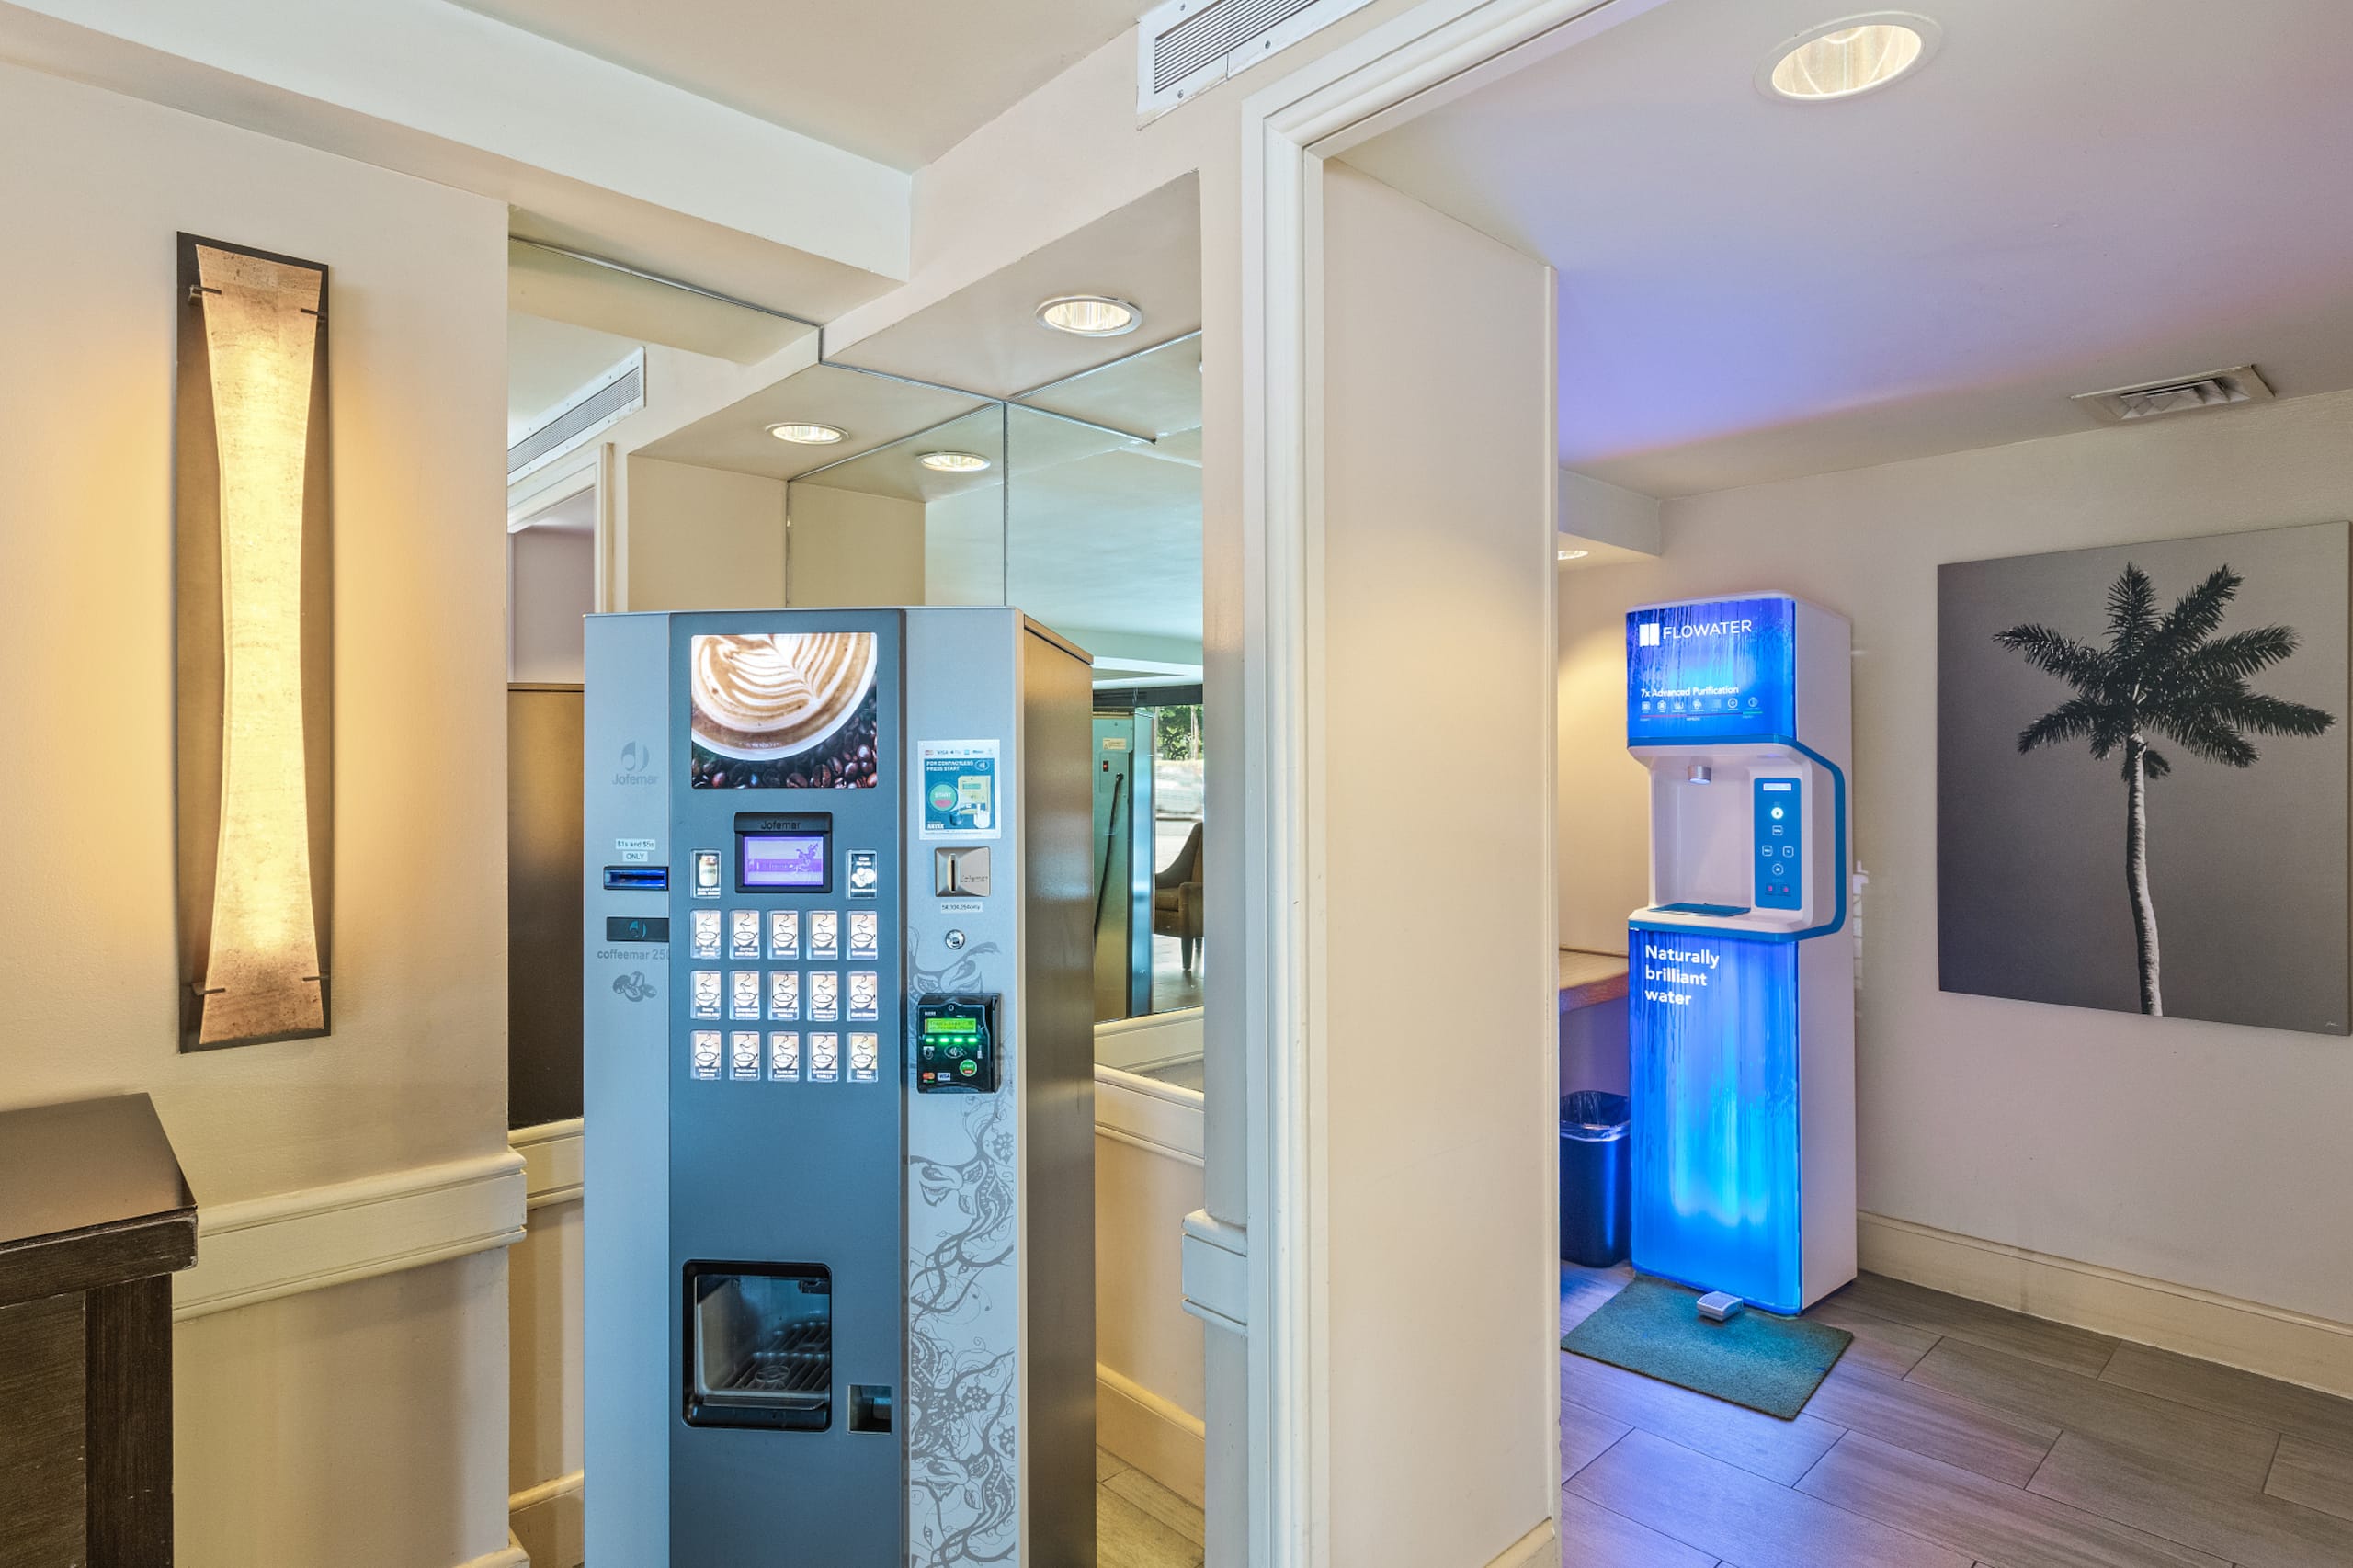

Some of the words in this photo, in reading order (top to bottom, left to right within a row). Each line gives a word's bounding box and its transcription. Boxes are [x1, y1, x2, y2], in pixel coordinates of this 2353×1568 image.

[1663, 619, 1752, 639] FLOWATER
[1641, 688, 1651, 698] 7x
[1652, 687, 1691, 697] Advanced
[1693, 686, 1739, 696] Purification
[612, 773, 658, 786] Jofemar
[761, 821, 801, 831] Jofemar
[626, 852, 645, 861] ONLY
[597, 949, 650, 960] coffeemar
[1645, 944, 1720, 970] Naturally
[1645, 964, 1707, 986] brilliant
[1644, 990, 1692, 1006] water
